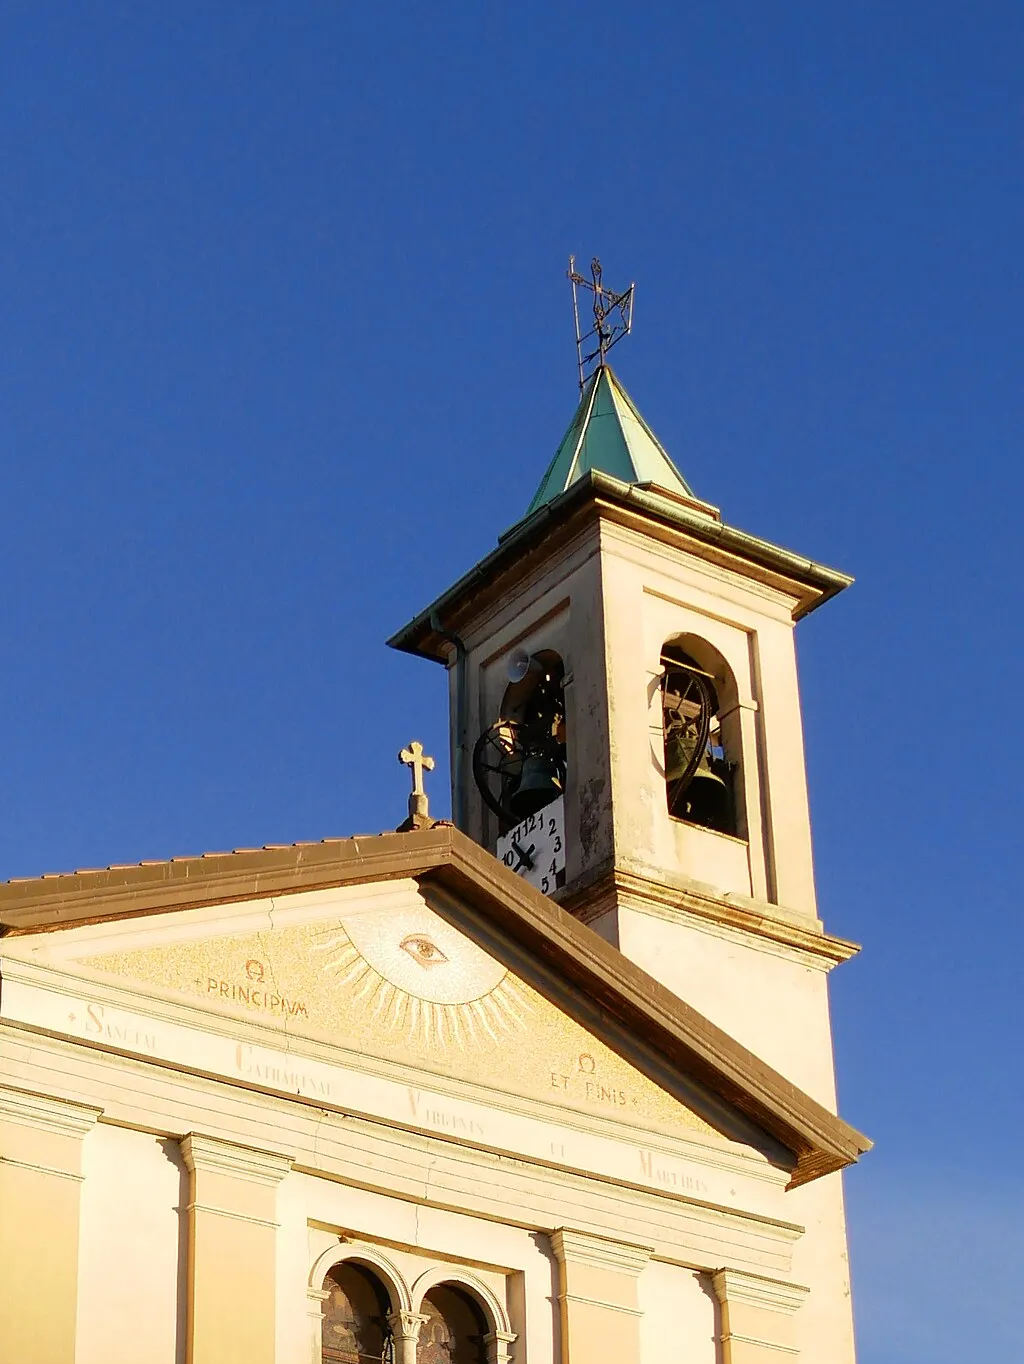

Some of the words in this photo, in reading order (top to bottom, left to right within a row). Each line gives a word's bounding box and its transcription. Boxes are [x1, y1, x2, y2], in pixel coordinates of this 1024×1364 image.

[523, 815, 537, 837] 12
[538, 813, 544, 830] 1
[549, 818, 557, 837] 2
[511, 826, 521, 844] 11
[553, 836, 562, 853] 3
[502, 850, 514, 867] 10
[549, 858, 557, 876] 4
[541, 876, 549, 894] 5
[551, 1071, 570, 1090] ET
